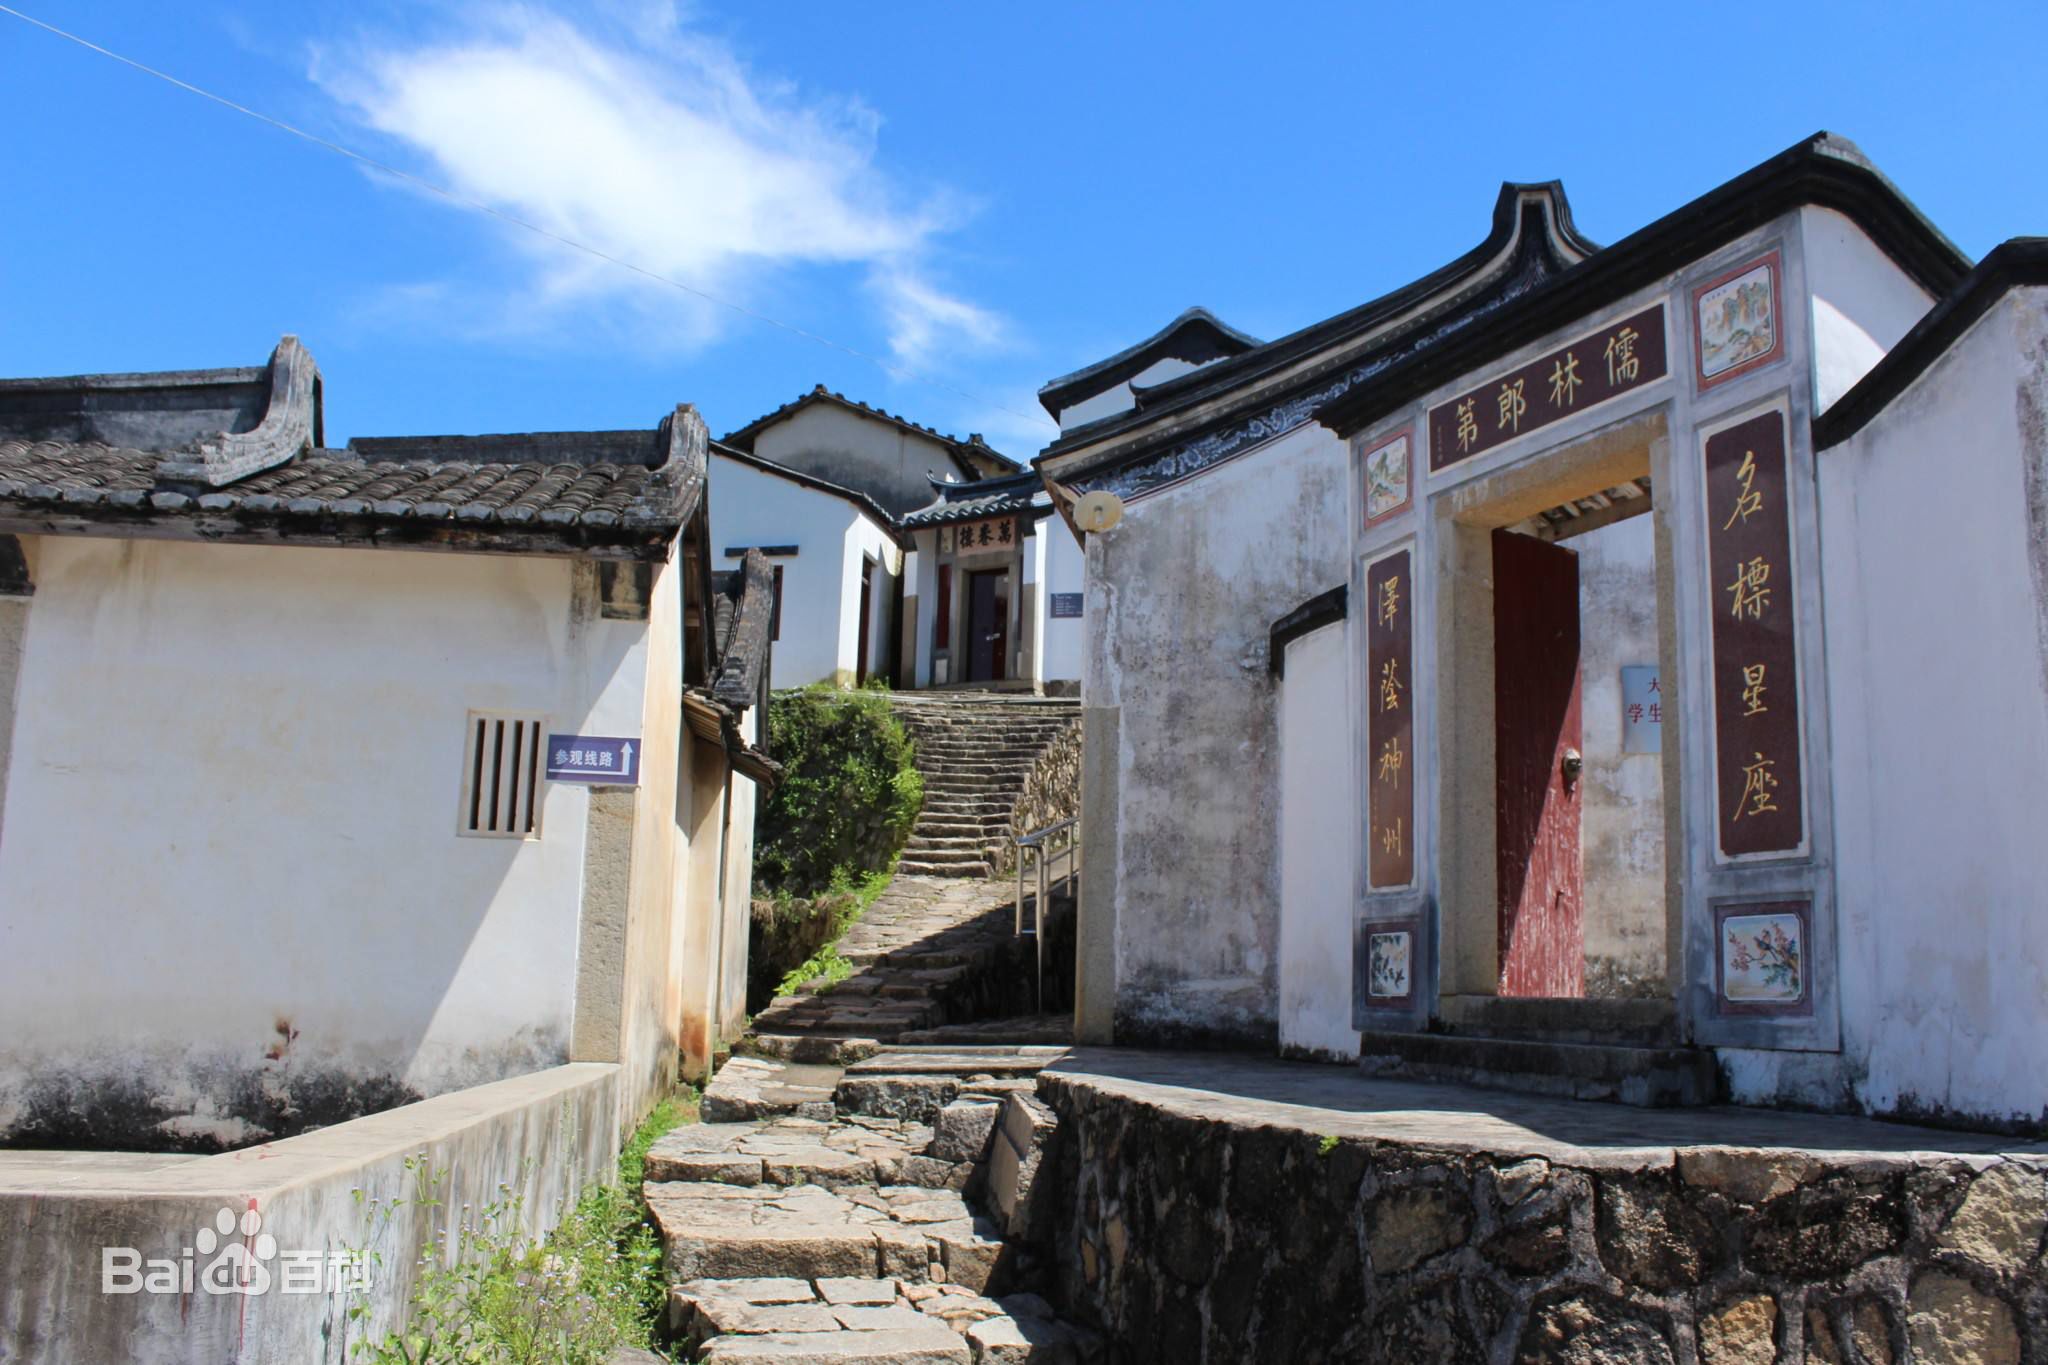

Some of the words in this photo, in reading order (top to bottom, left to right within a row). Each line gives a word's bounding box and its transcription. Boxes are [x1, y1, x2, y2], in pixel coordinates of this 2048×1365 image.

[1723, 450, 1778, 822] 名標星座
[1628, 703, 1664, 724] 学生
[555, 748, 613, 767] 参观线路
